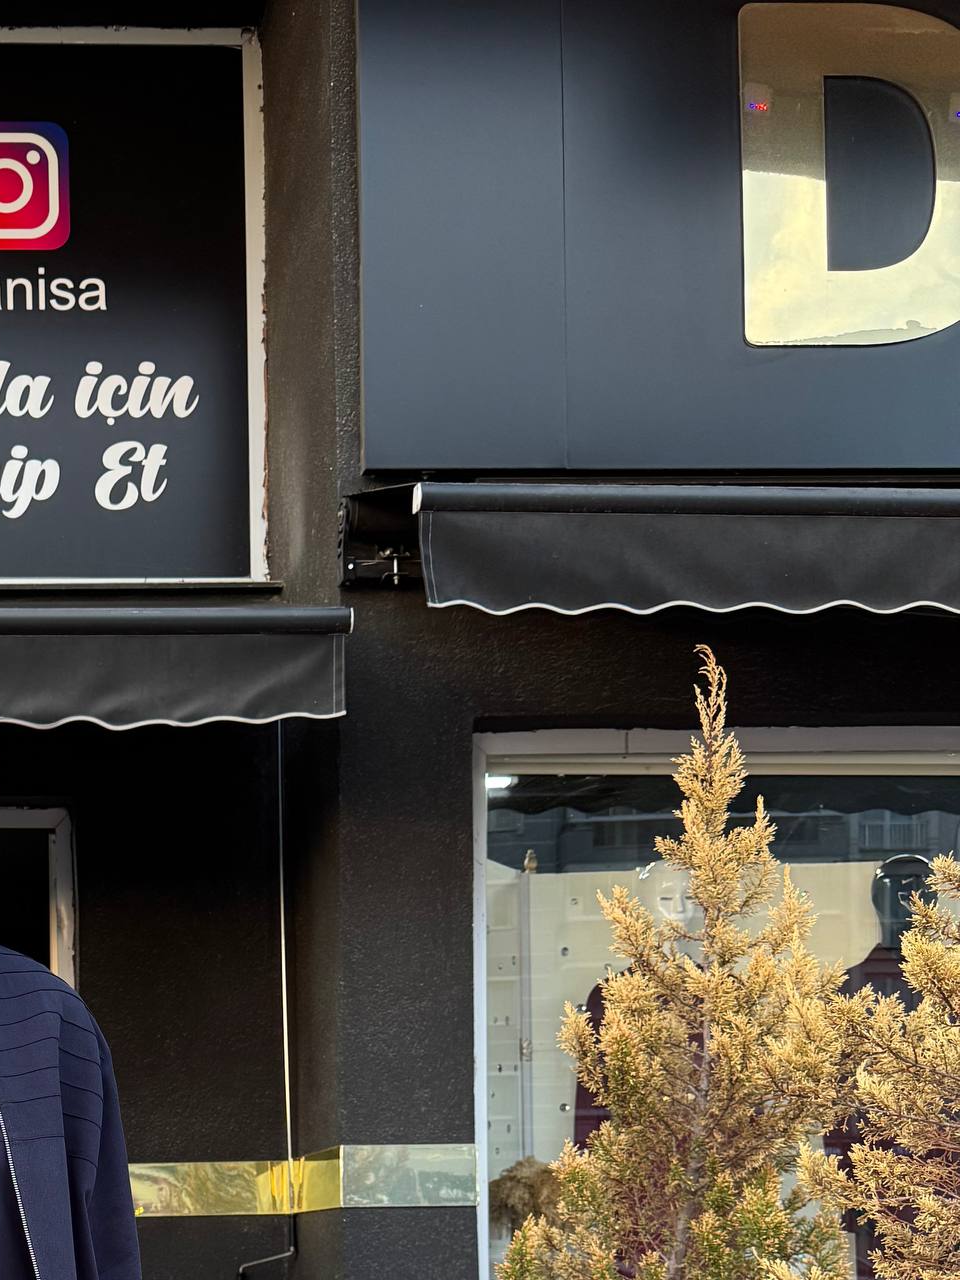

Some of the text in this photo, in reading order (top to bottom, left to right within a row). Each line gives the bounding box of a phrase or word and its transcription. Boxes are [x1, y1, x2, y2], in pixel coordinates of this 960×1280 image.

[737, 2, 960, 346] D
[74, 361, 199, 426] için
[95, 440, 168, 511] Et
